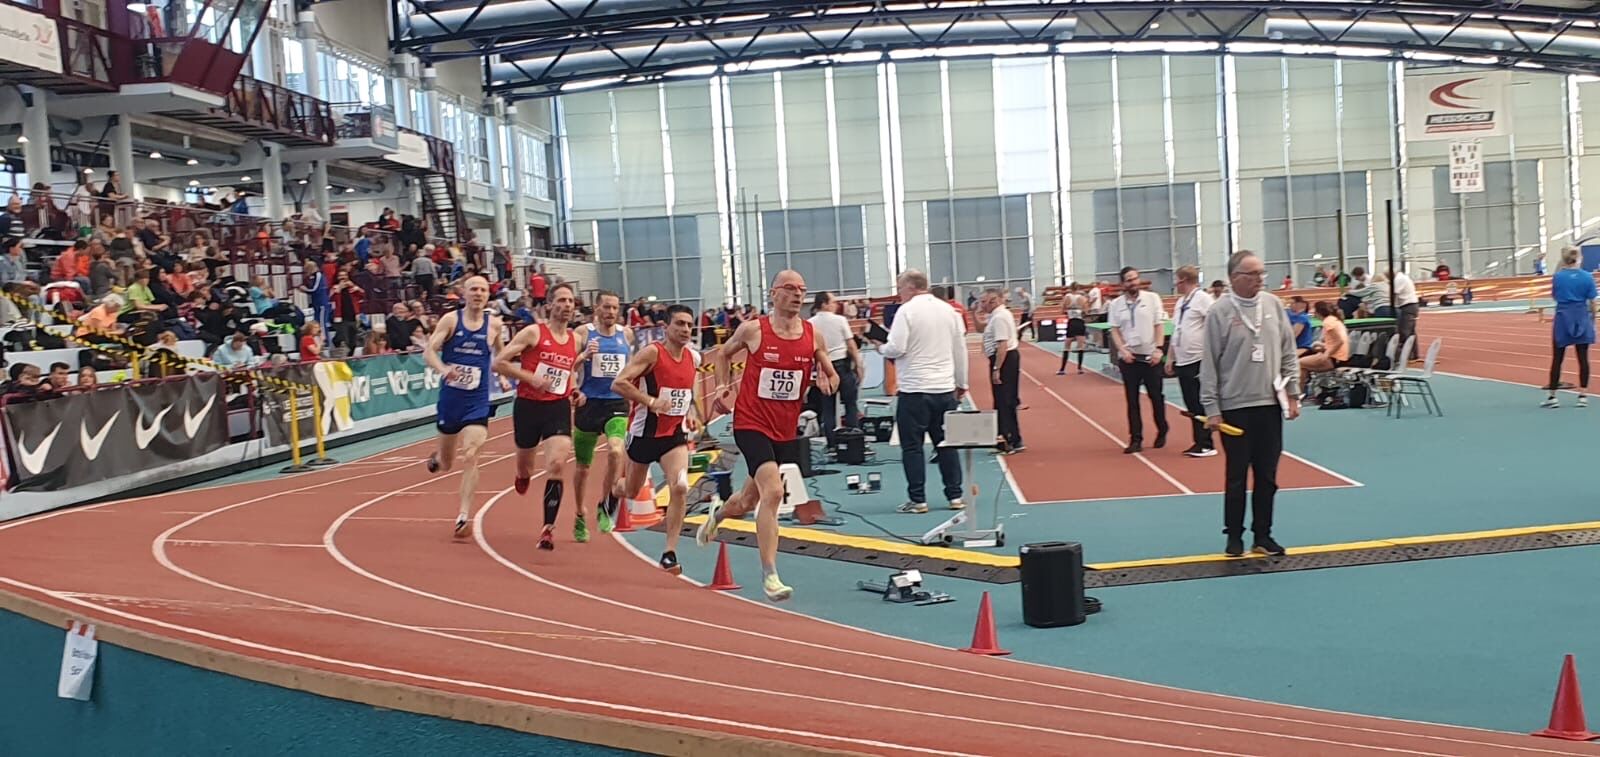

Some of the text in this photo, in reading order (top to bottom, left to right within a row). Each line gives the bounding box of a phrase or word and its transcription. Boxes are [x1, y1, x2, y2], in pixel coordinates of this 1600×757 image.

[600, 362, 620, 371] 573
[547, 367, 562, 376] GLS
[772, 370, 794, 379] GLS
[769, 380, 794, 392] 170
